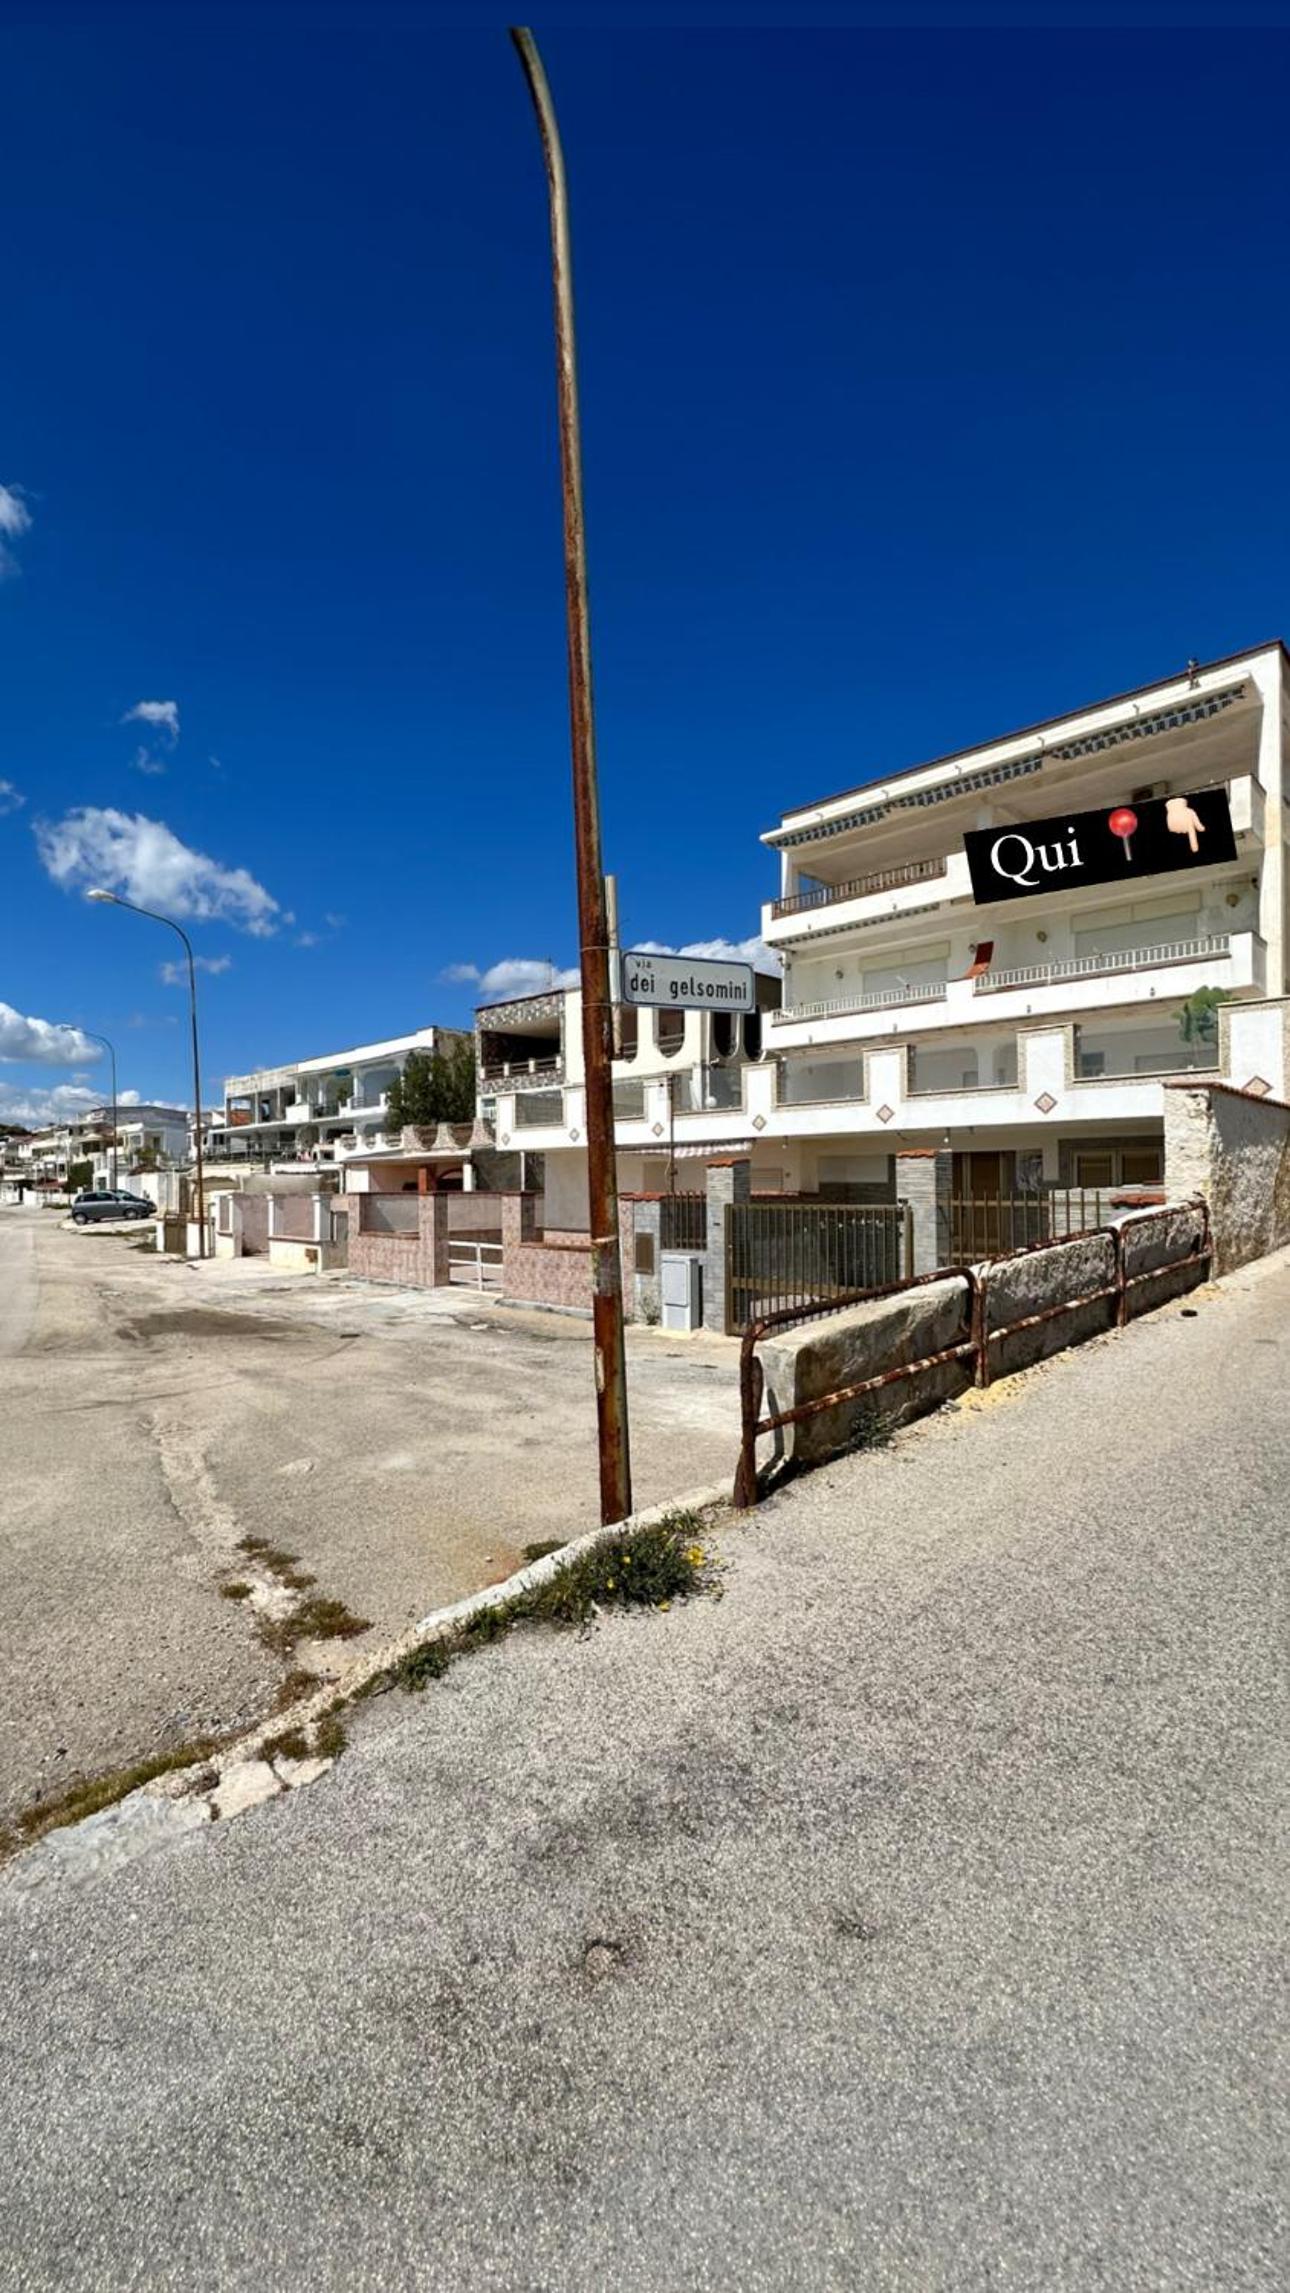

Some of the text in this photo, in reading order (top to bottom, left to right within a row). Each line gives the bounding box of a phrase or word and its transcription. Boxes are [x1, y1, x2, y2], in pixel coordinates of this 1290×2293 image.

[636, 959, 651, 969] via
[630, 974, 747, 1000] dei gelsomini
